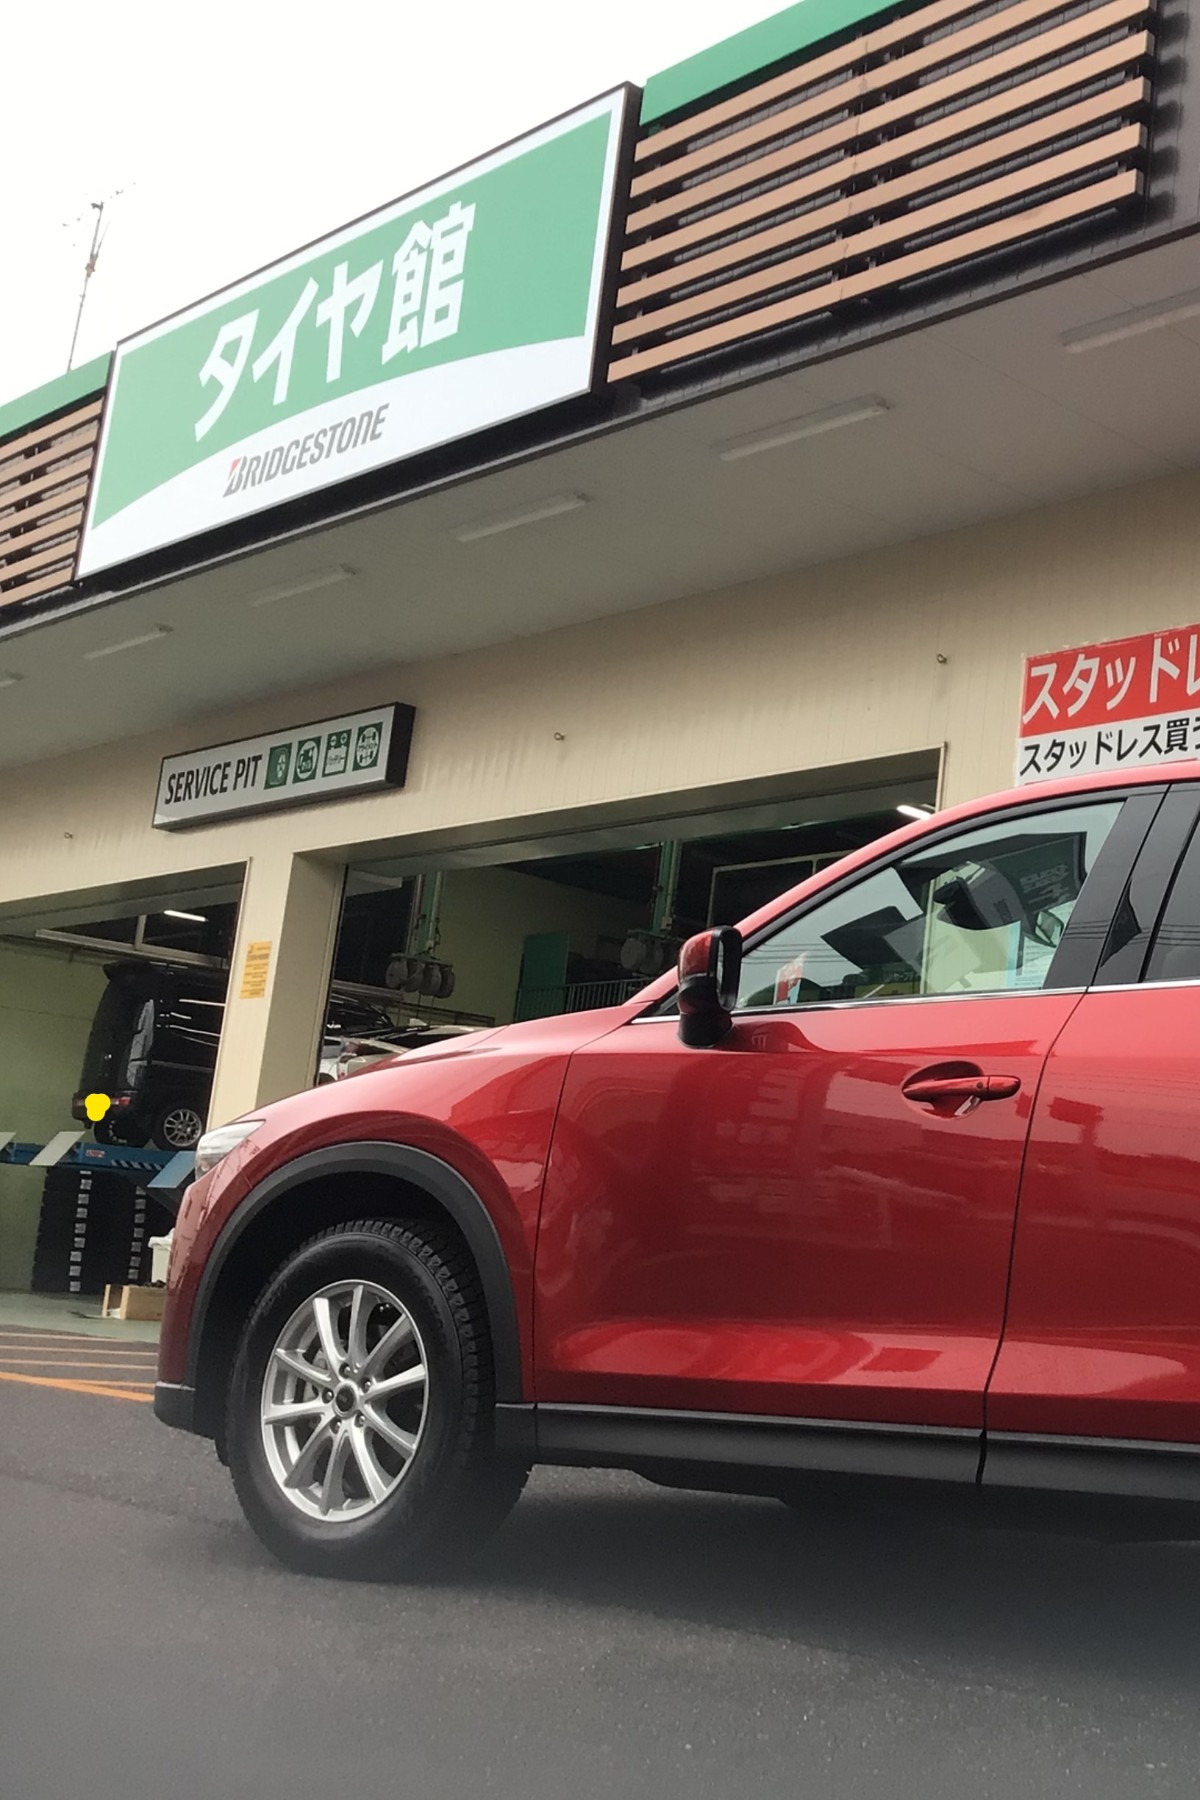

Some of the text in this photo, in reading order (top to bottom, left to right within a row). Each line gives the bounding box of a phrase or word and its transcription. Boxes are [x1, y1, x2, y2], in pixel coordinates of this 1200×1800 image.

[195, 200, 476, 442] タイヤ館
[223, 403, 390, 498] BRIDGESTONE
[165, 754, 263, 804] SERVICE PIT
